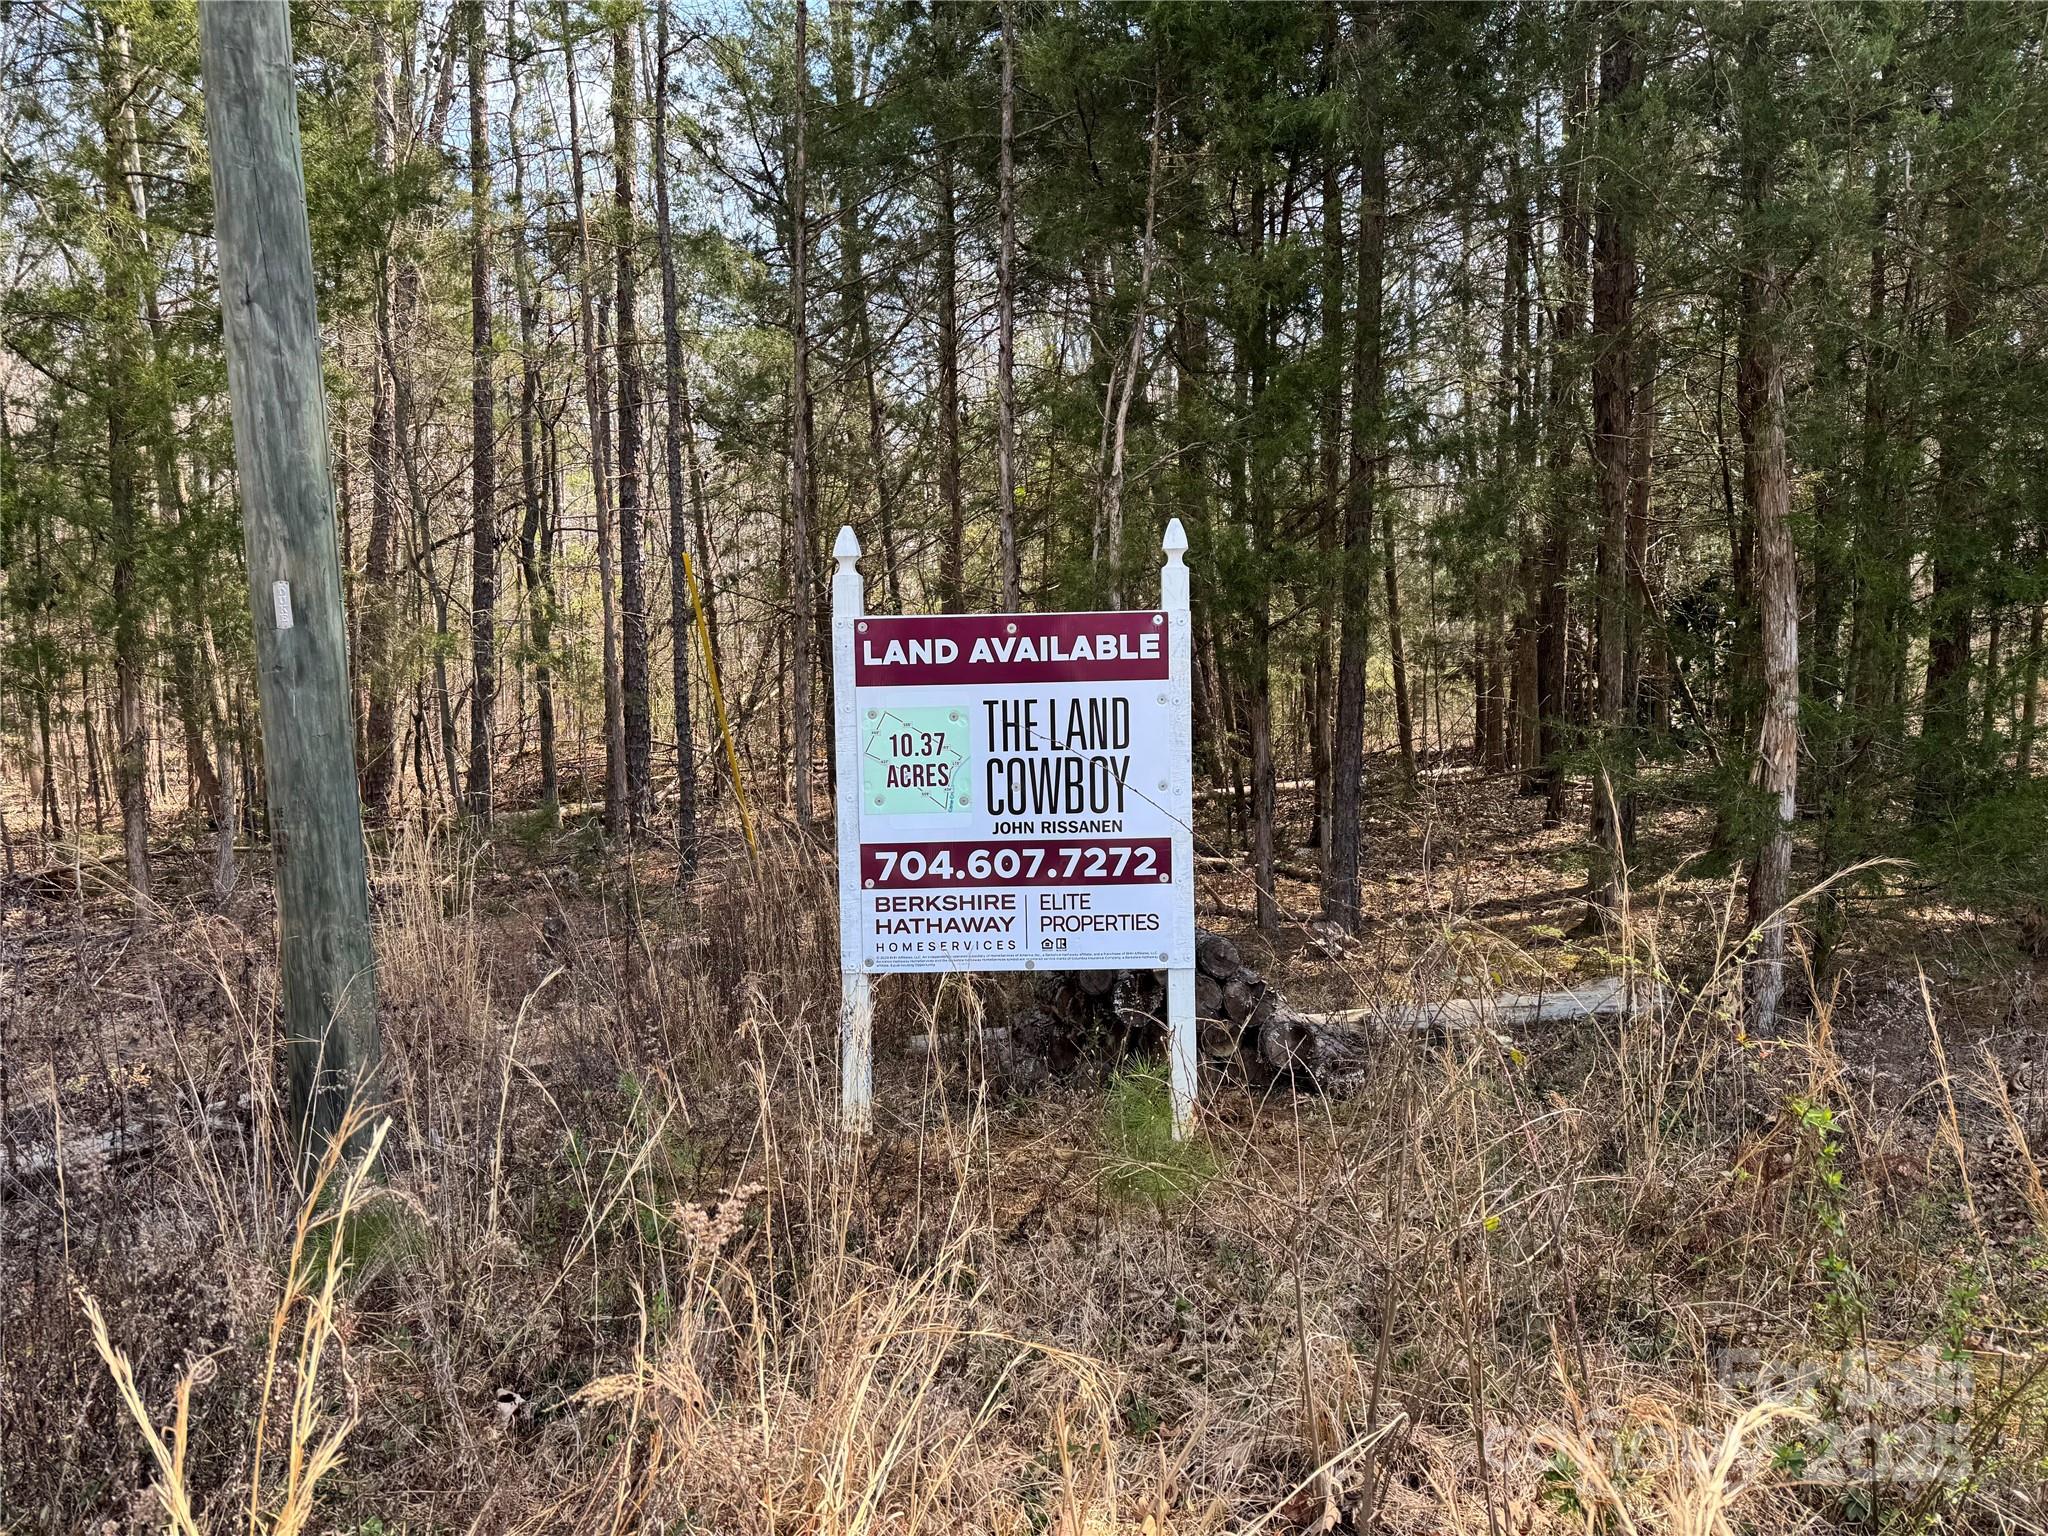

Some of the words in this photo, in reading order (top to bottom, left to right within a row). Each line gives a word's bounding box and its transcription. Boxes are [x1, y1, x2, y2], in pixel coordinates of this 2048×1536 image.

[864, 639, 958, 666] LAND
[969, 634, 1160, 664] AVAILABLE
[983, 699, 1038, 752] THE
[1050, 697, 1130, 752] LAND
[890, 732, 945, 757] 10.37
[887, 763, 949, 788] ACRES
[987, 755, 1130, 815] COWBOY
[993, 821, 1035, 835] JOHN
[1041, 820, 1123, 834] RISSANEN
[876, 847, 1156, 880] 704.607.7272
[875, 894, 1016, 912] BERKSHIRE
[1041, 893, 1091, 910] ELITE
[875, 917, 1016, 935] HATHAWAY
[1041, 914, 1160, 932] PROPERTIES
[876, 940, 1016, 952] HOMESERVICES
